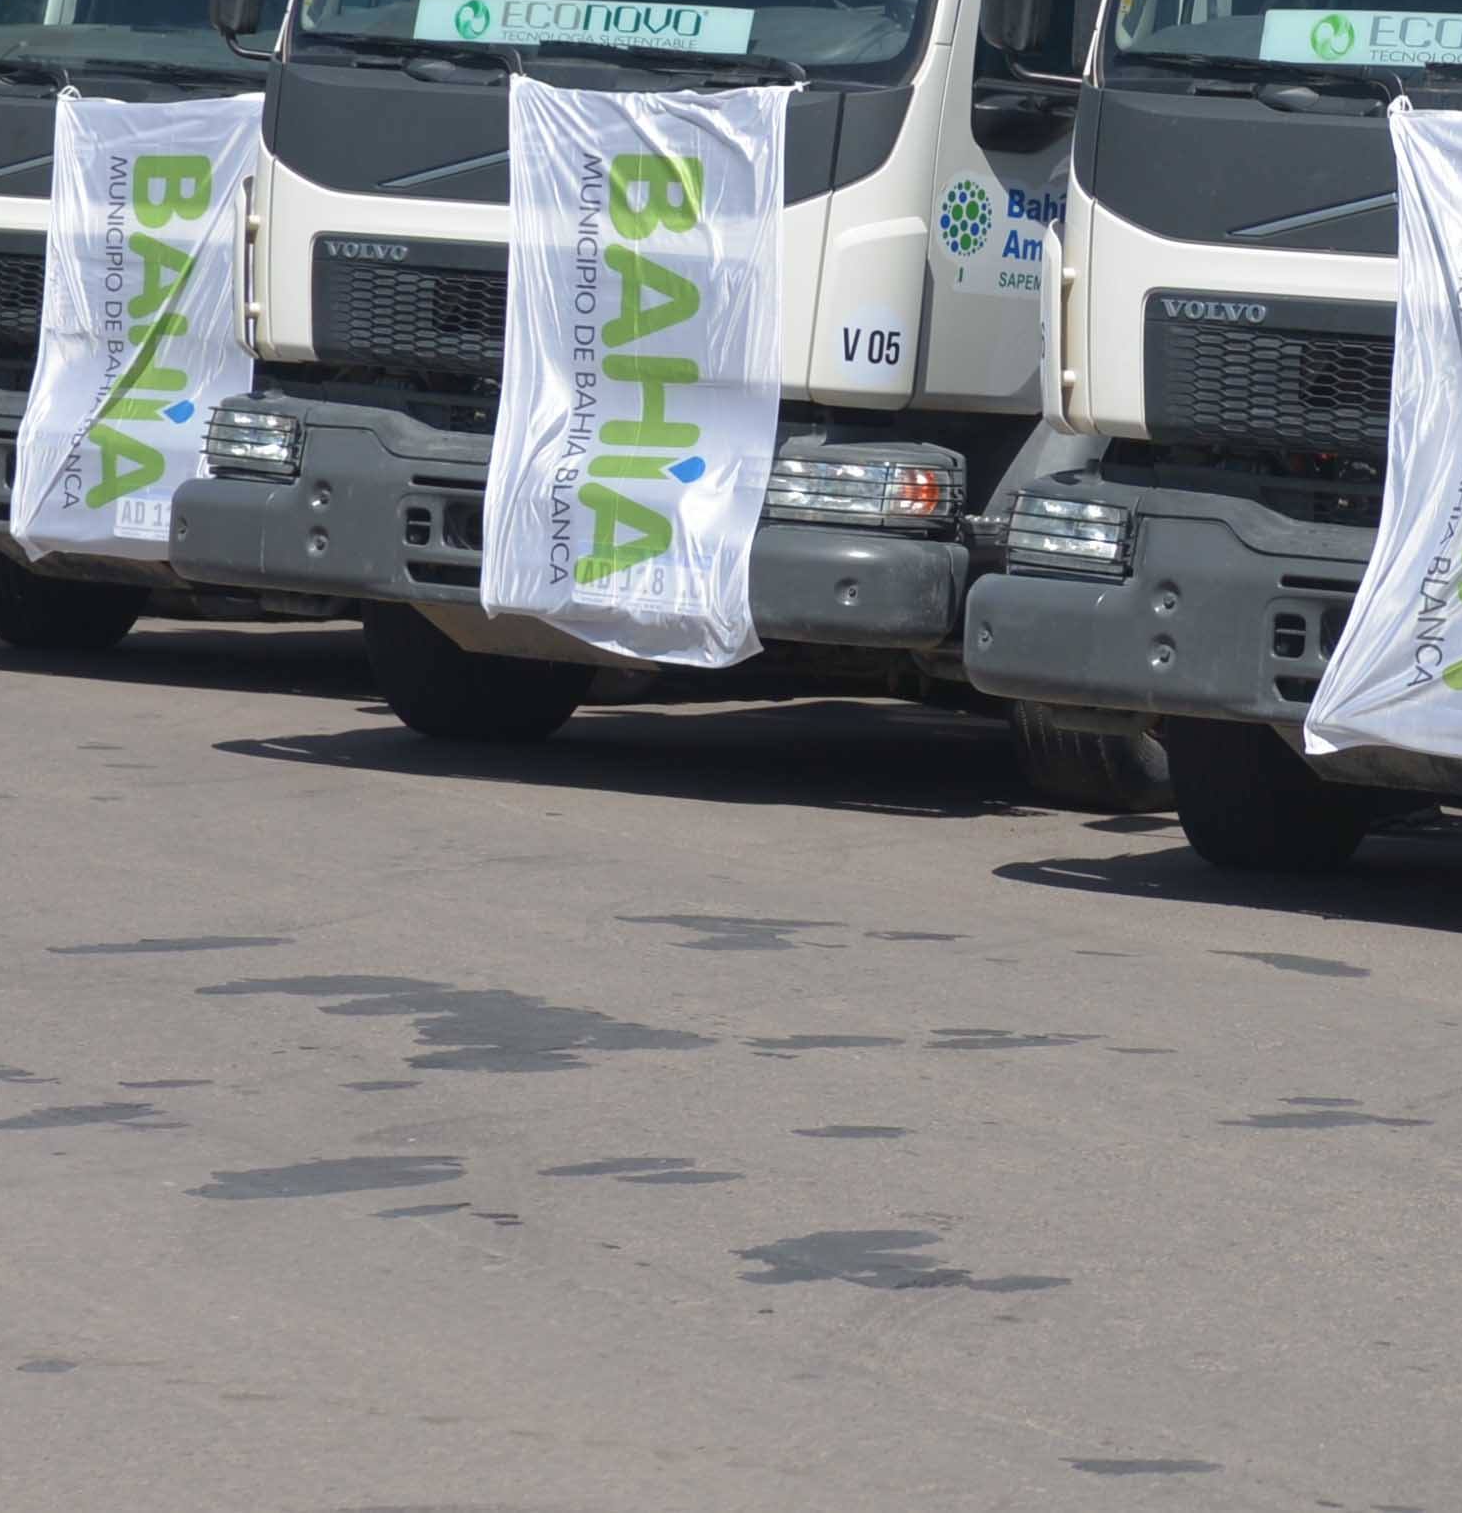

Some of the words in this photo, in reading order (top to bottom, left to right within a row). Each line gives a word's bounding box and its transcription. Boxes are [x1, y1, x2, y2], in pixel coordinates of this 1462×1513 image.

[501, 0, 702, 37] ECONOVO
[105, 155, 128, 292] MUNICIPIO
[574, 152, 603, 316] MUNICIPIO
[324, 240, 408, 261] VOLVO
[103, 301, 123, 332] DE
[1161, 298, 1267, 324] VOLVO
[573, 324, 596, 362] DE
[843, 327, 861, 362] V
[867, 329, 901, 366] 05
[564, 371, 597, 459] BAHIA
[548, 467, 580, 586] BLANCA
[1406, 555, 1451, 688] BLANCA
